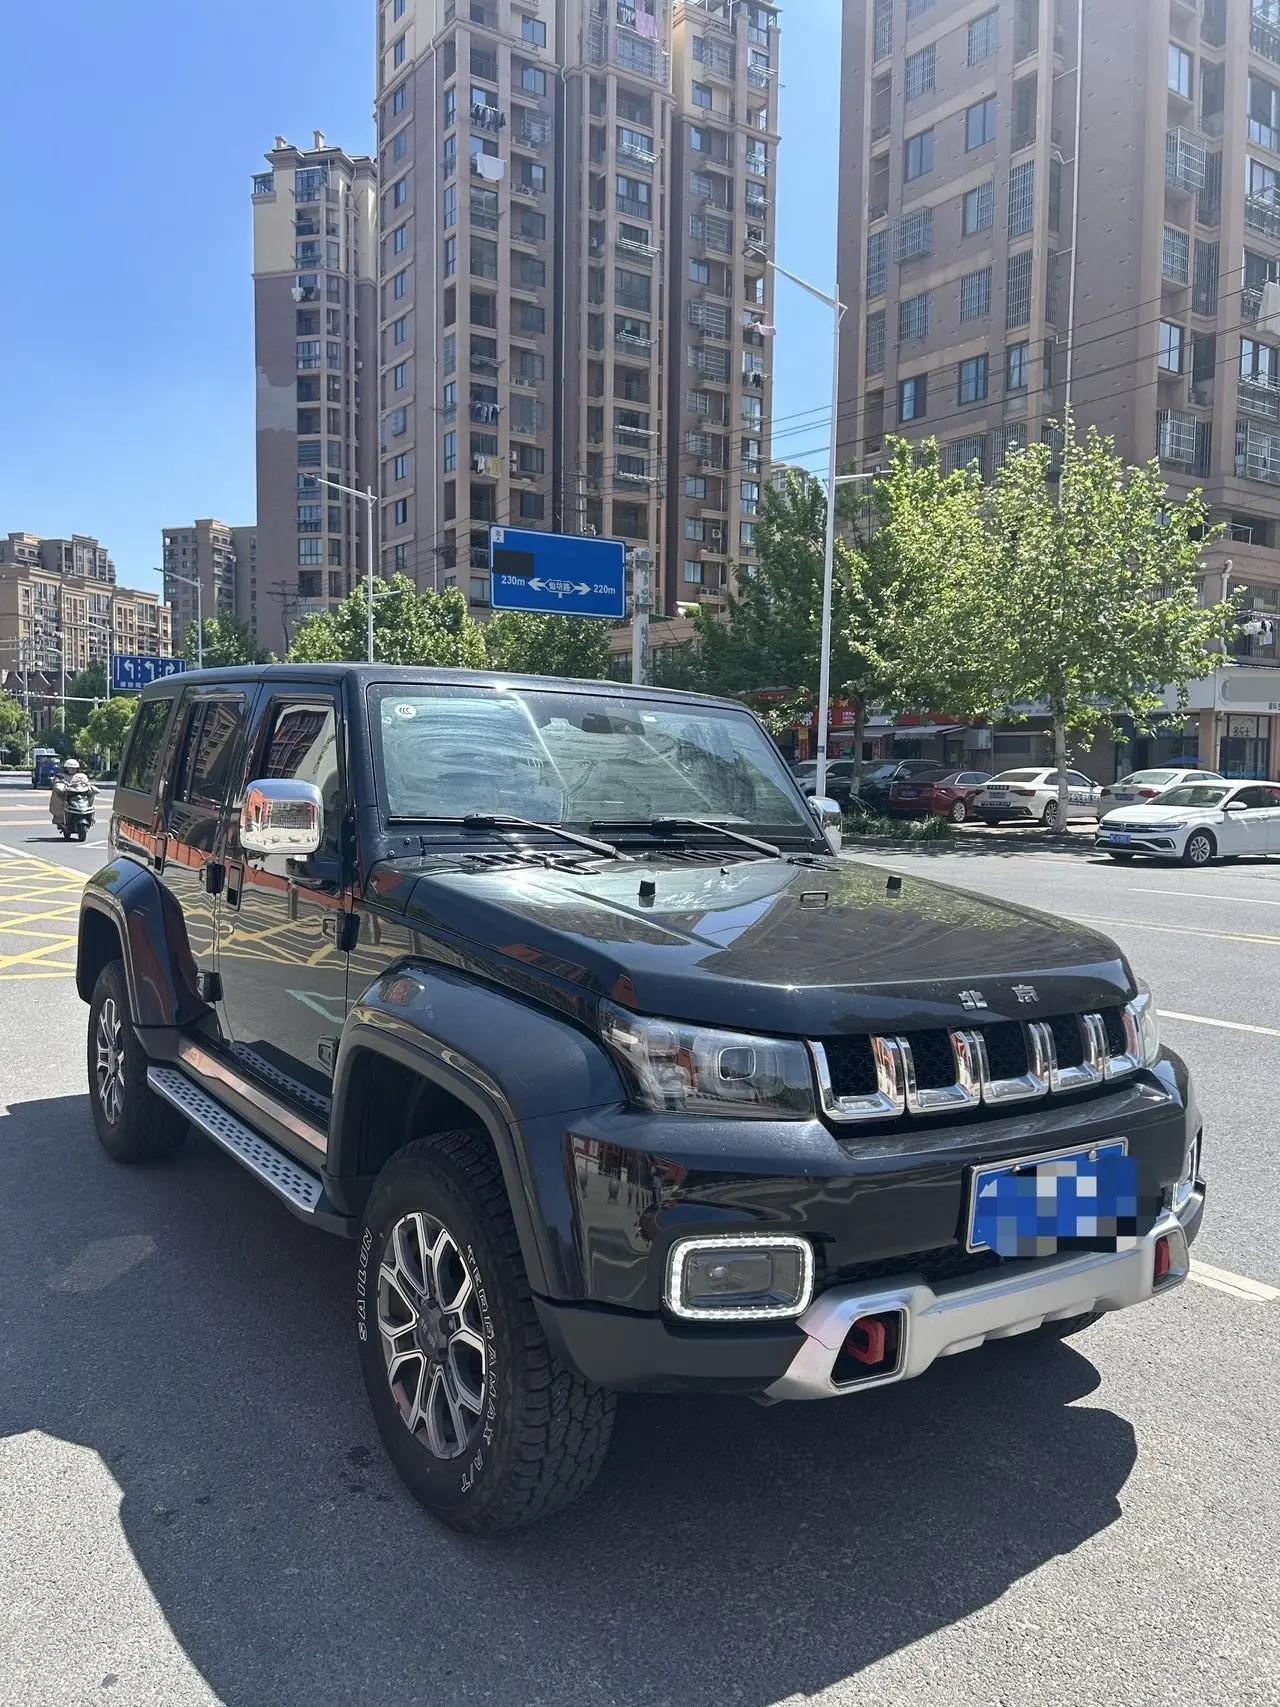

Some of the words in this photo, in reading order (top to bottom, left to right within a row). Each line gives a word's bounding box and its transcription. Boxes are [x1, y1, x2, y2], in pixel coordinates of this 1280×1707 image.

[501, 575, 526, 587] 230m
[593, 584, 616, 595] 220m
[958, 984, 1040, 1011] 北京
[357, 1227, 373, 1341] SAILUN
[466, 1244, 499, 1446] TERRAMAX
[460, 1449, 485, 1493] A/T
